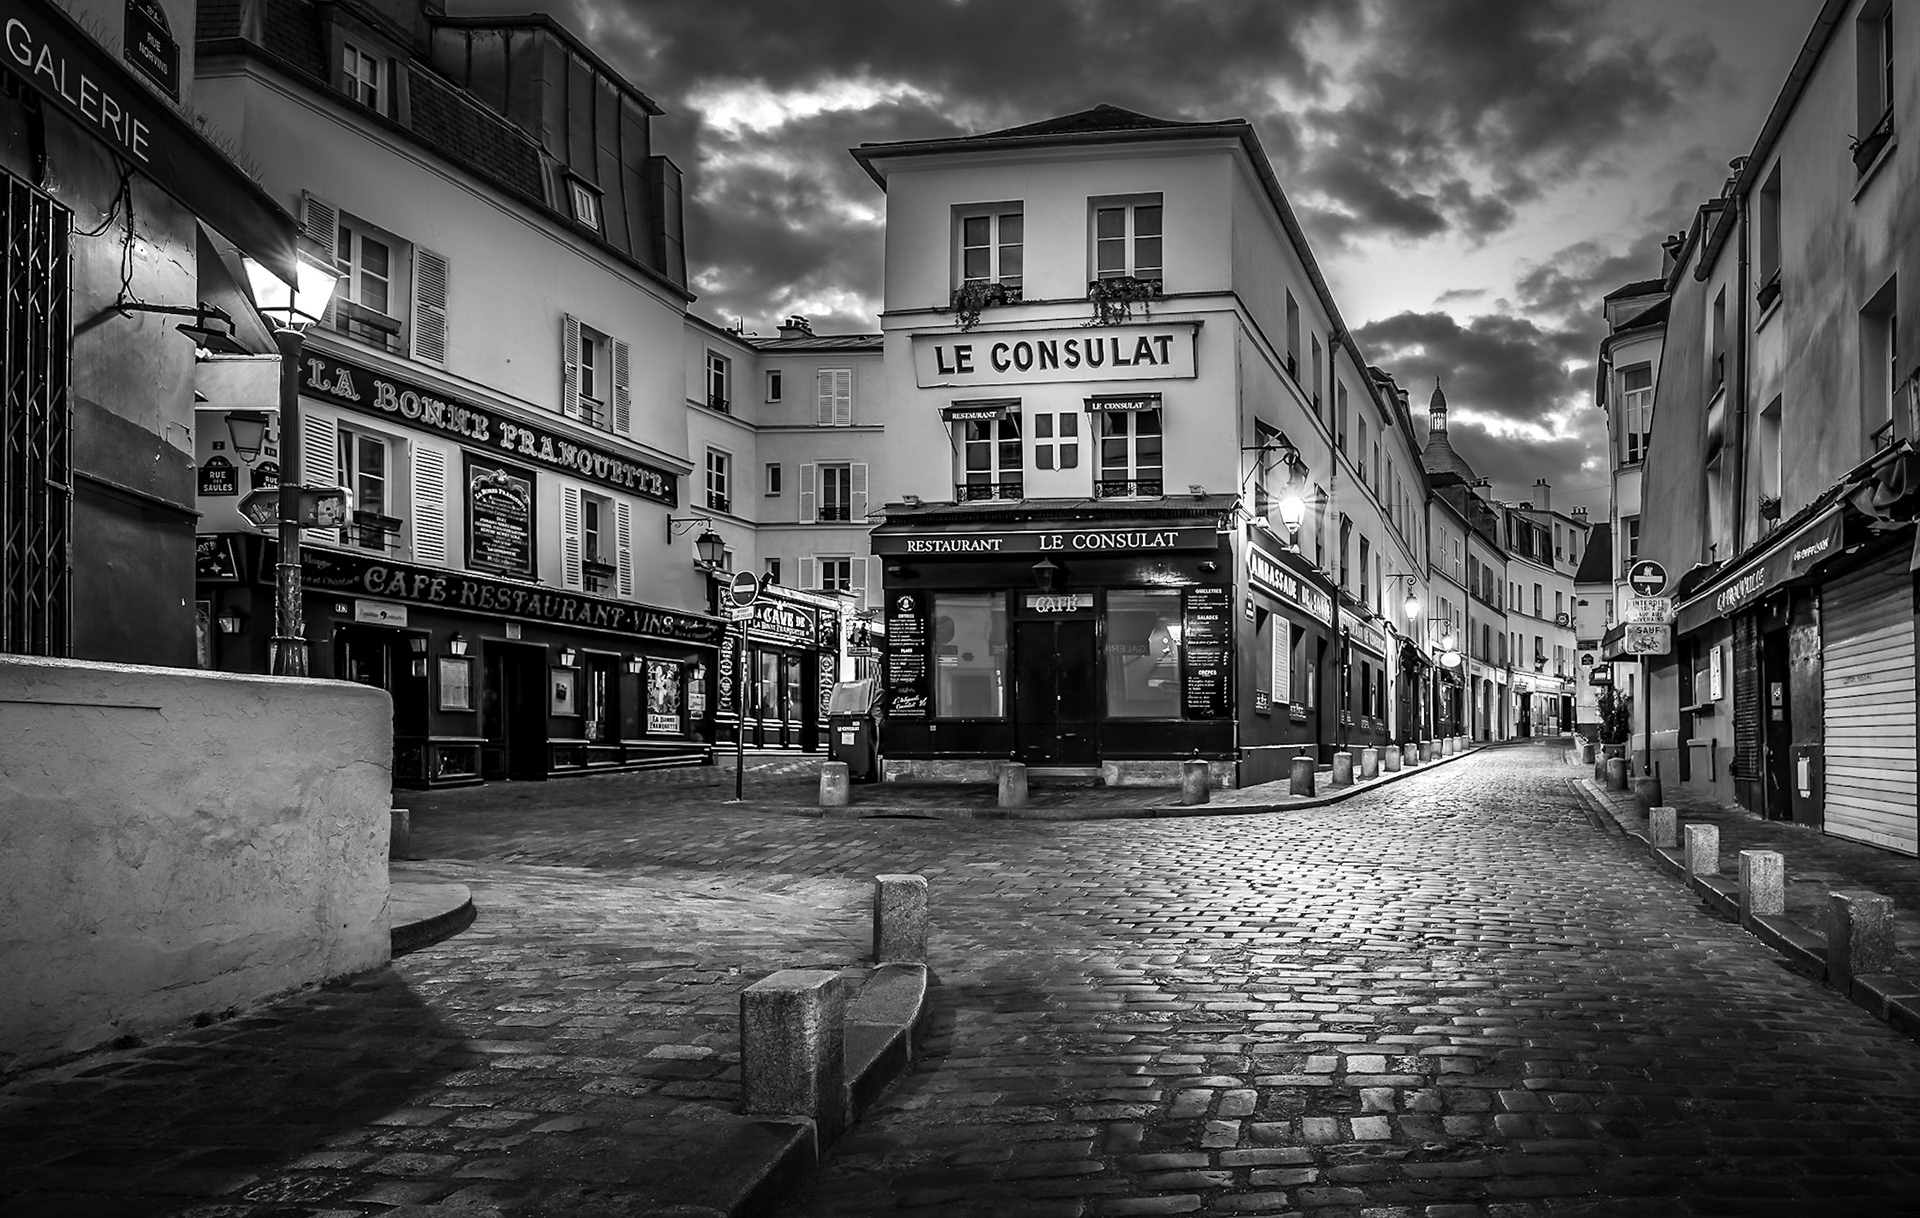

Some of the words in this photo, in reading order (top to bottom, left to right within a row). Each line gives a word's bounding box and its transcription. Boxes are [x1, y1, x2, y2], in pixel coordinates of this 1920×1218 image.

[147, 32, 161, 53] RUE
[5, 17, 150, 163] GALERIE
[934, 345, 975, 376] LE
[990, 335, 1174, 373] CONSULAT
[952, 410, 998, 420] RESTAURANT
[1092, 402, 1103, 410] LE
[1105, 401, 1144, 410] CONSULAT
[306, 357, 360, 401] LA
[374, 379, 489, 442] BONNE
[500, 421, 665, 497] FRANQUETTE
[210, 471, 226, 479] RUE
[265, 476, 278, 484] RUE
[204, 484, 233, 492] SAULES
[907, 538, 1003, 552] RESTAURANT
[1039, 535, 1065, 550] LE
[1072, 532, 1179, 549] CONSULAT
[1251, 553, 1297, 600] AMBASSADE
[364, 565, 447, 602] CAFÉ
[461, 581, 625, 628] RESTAURANT
[634, 610, 674, 635] VINS
[1036, 594, 1078, 613] CAFÉ
[763, 607, 793, 628] CAVE
[795, 616, 805, 628] DE
[1637, 626, 1660, 634] SAUF
